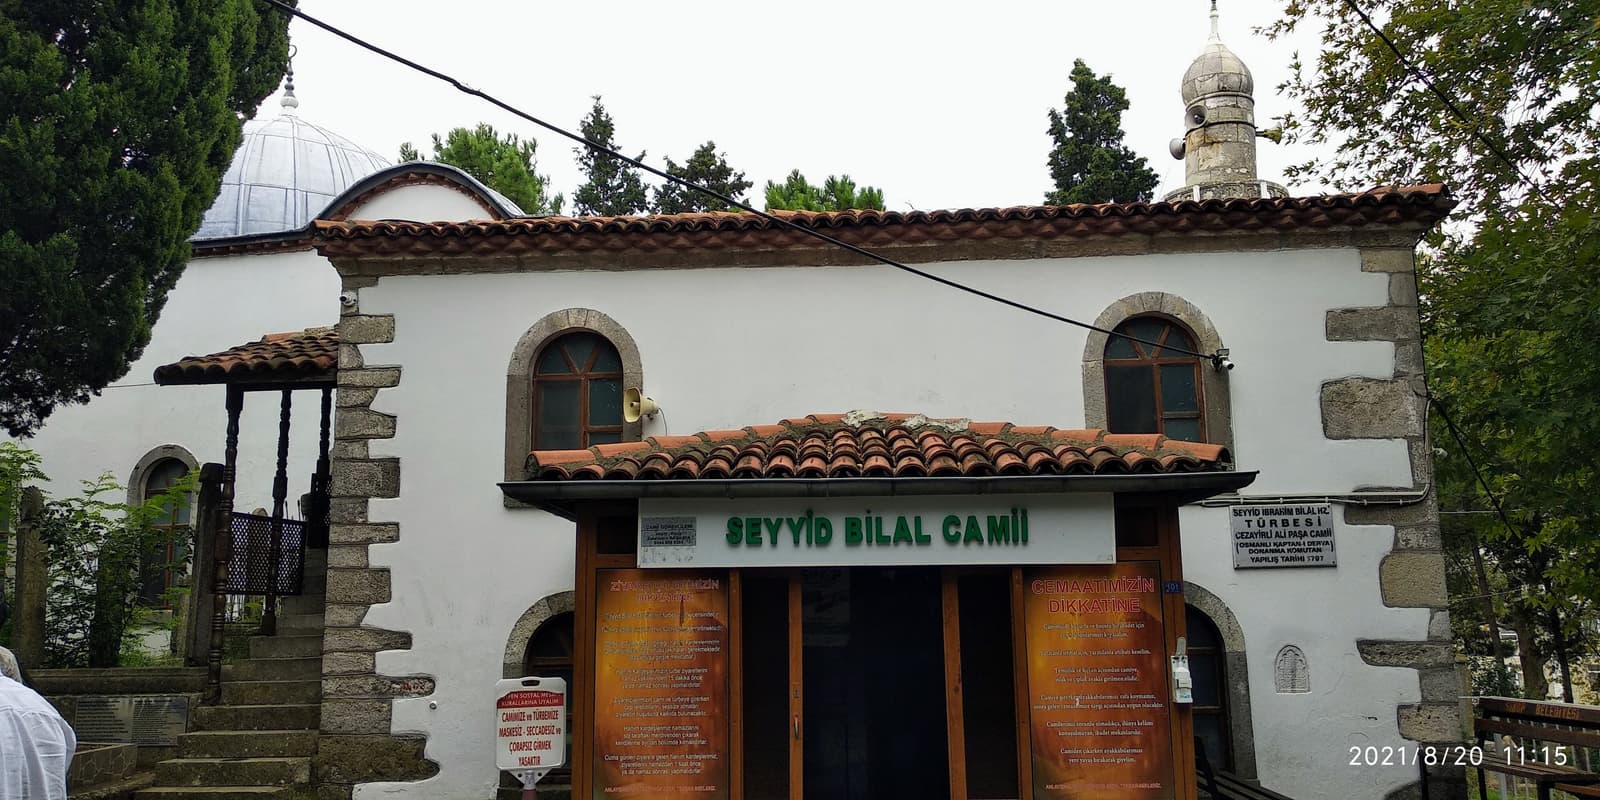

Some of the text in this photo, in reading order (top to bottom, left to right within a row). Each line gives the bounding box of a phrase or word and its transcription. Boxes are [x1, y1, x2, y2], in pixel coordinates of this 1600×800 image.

[1233, 506, 1260, 517] SEYYİD
[726, 507, 1029, 545] SEYYİD BİLAL CAMİİ
[1235, 529, 1273, 540] CEZAYİRLİ
[1274, 528, 1287, 539] ALİ
[1288, 529, 1309, 540] PAŞA
[1248, 547, 1286, 555] DONANMA
[1250, 555, 1279, 564] YAPILIŞ
[1031, 575, 1155, 595] CEMAATİMİZİN
[1047, 596, 1142, 614] DİKKATİNE
[555, 727, 561, 735] ve
[519, 756, 541, 766] YASAKTIR
